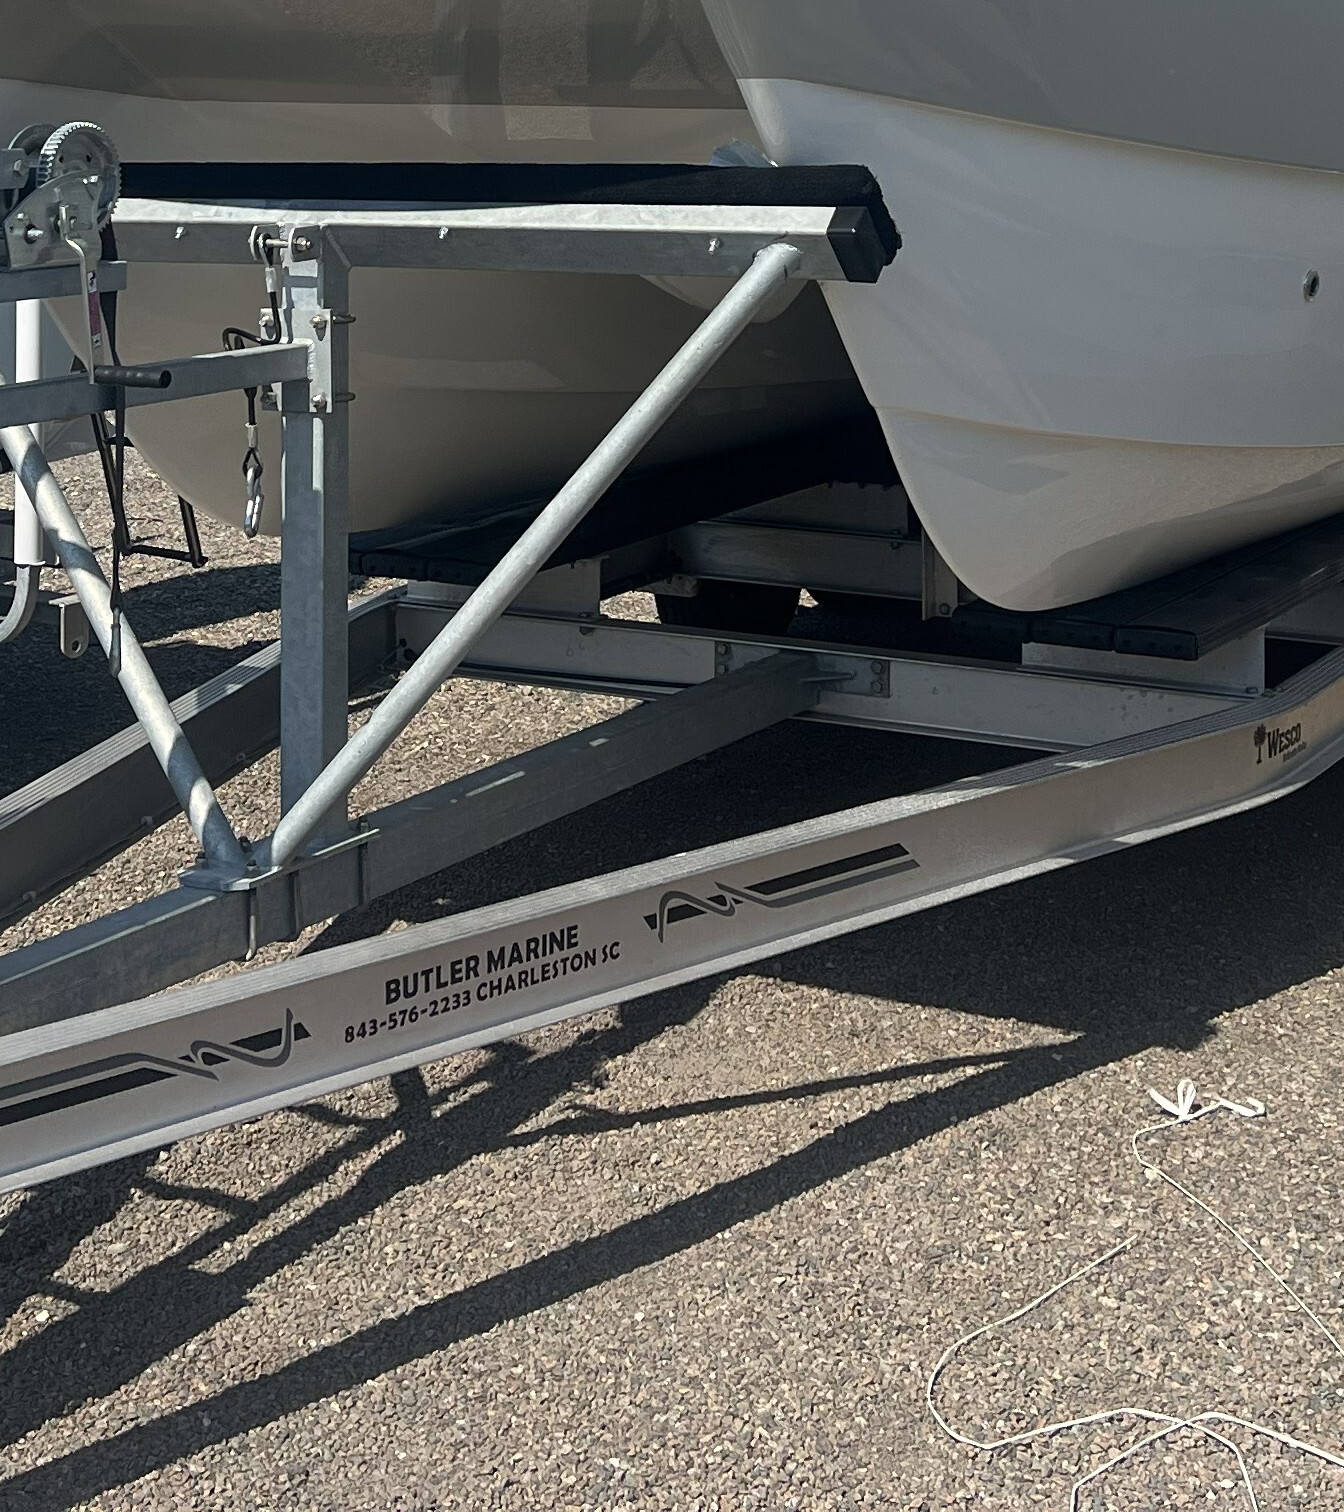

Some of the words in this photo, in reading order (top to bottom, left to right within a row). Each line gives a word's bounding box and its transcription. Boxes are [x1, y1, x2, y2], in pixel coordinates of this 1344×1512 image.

[344, 989, 472, 1044] 843-576-2233
[476, 948, 597, 1002] CHARLESTON
[601, 941, 621, 964] SC
[384, 954, 481, 1005] BUTLER
[486, 924, 579, 975] MARINE
